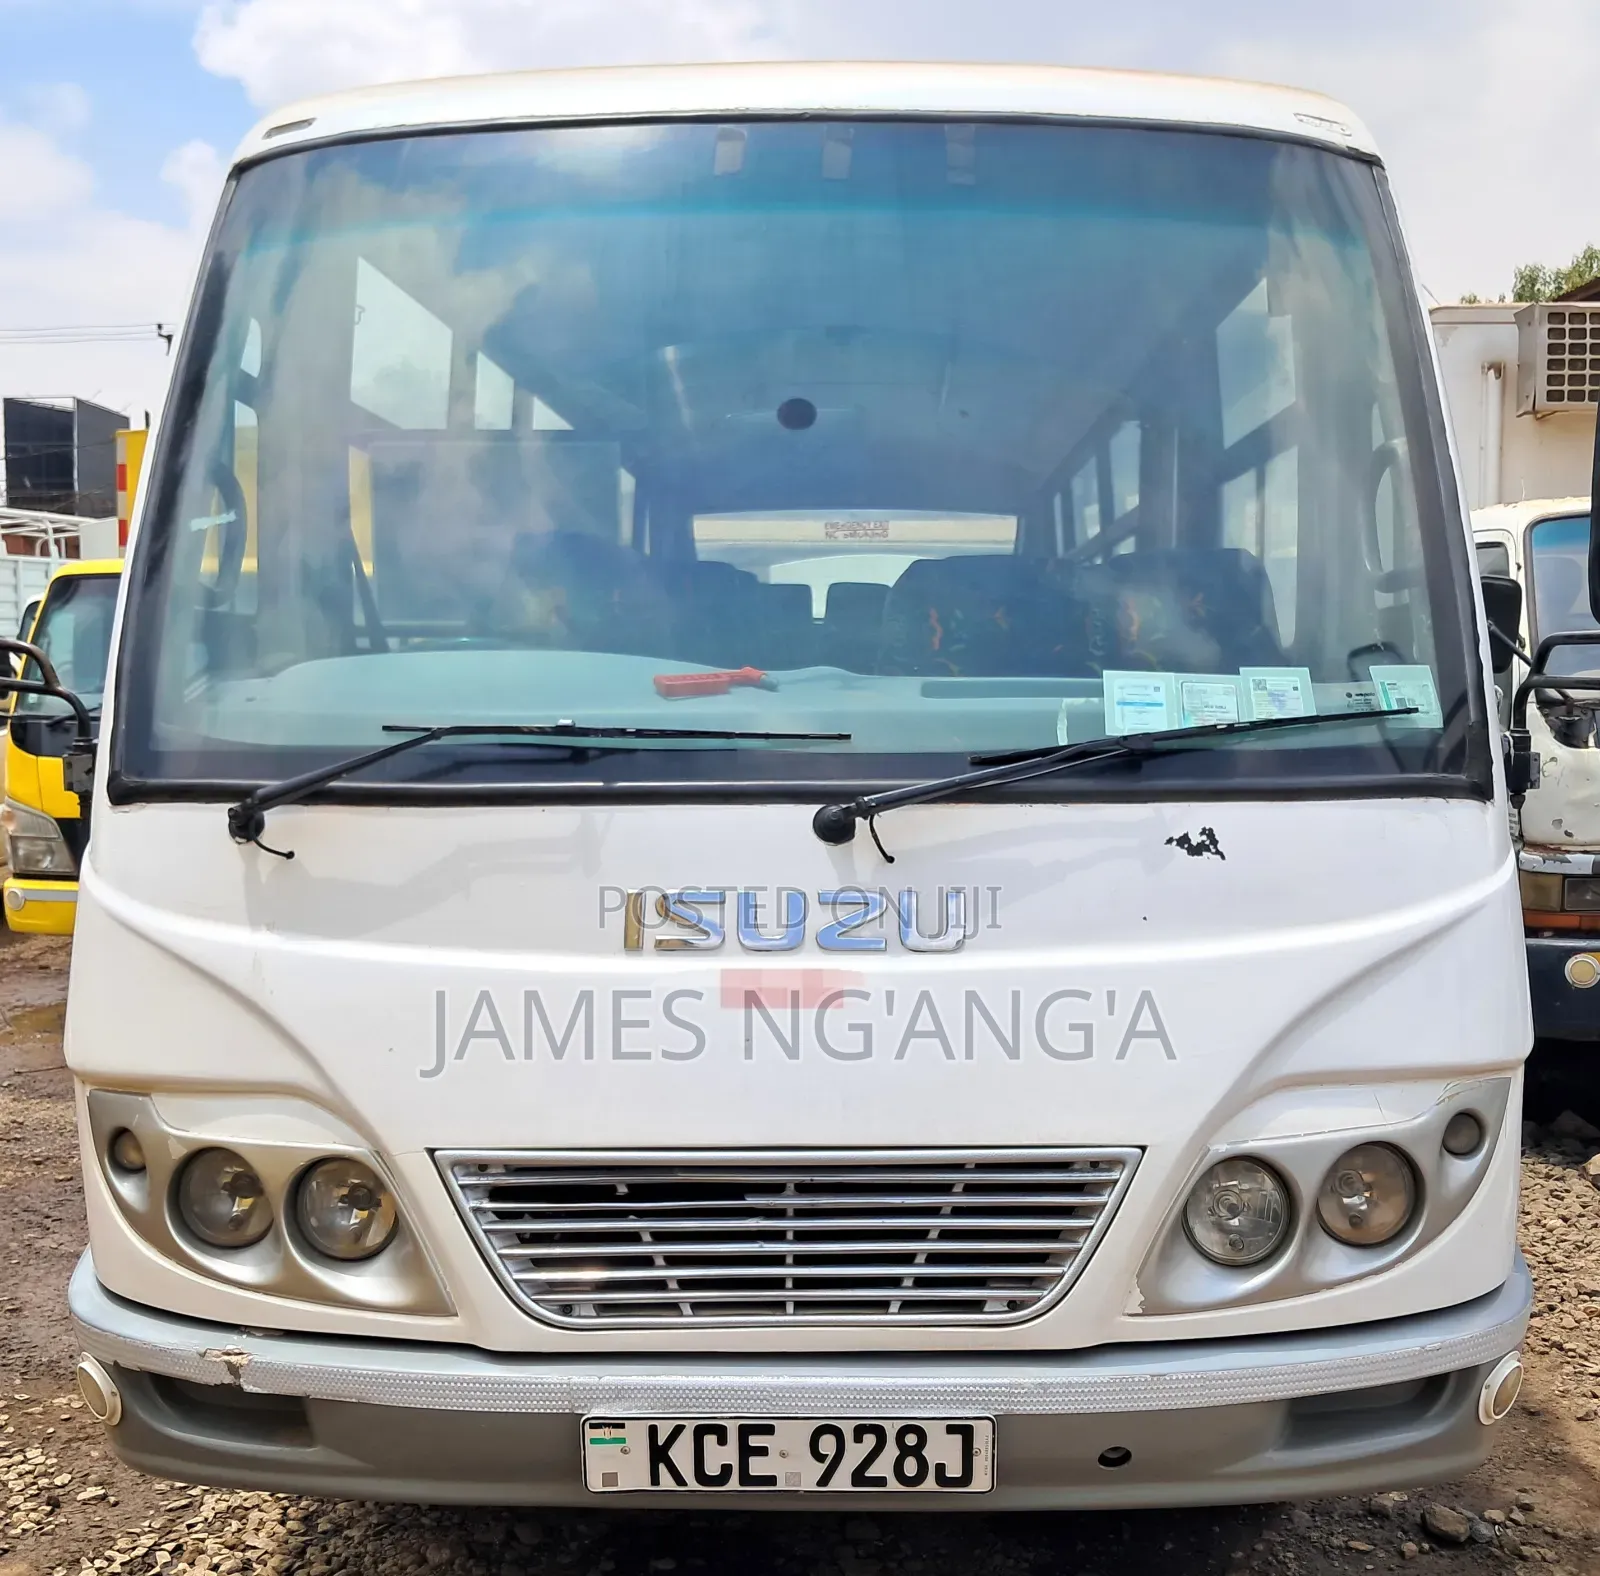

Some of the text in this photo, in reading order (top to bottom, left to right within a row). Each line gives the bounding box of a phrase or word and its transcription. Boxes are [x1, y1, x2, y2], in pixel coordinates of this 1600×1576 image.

[623, 888, 967, 953] ISUZU
[647, 1422, 778, 1488] KCE
[808, 1422, 976, 1489] 928J
